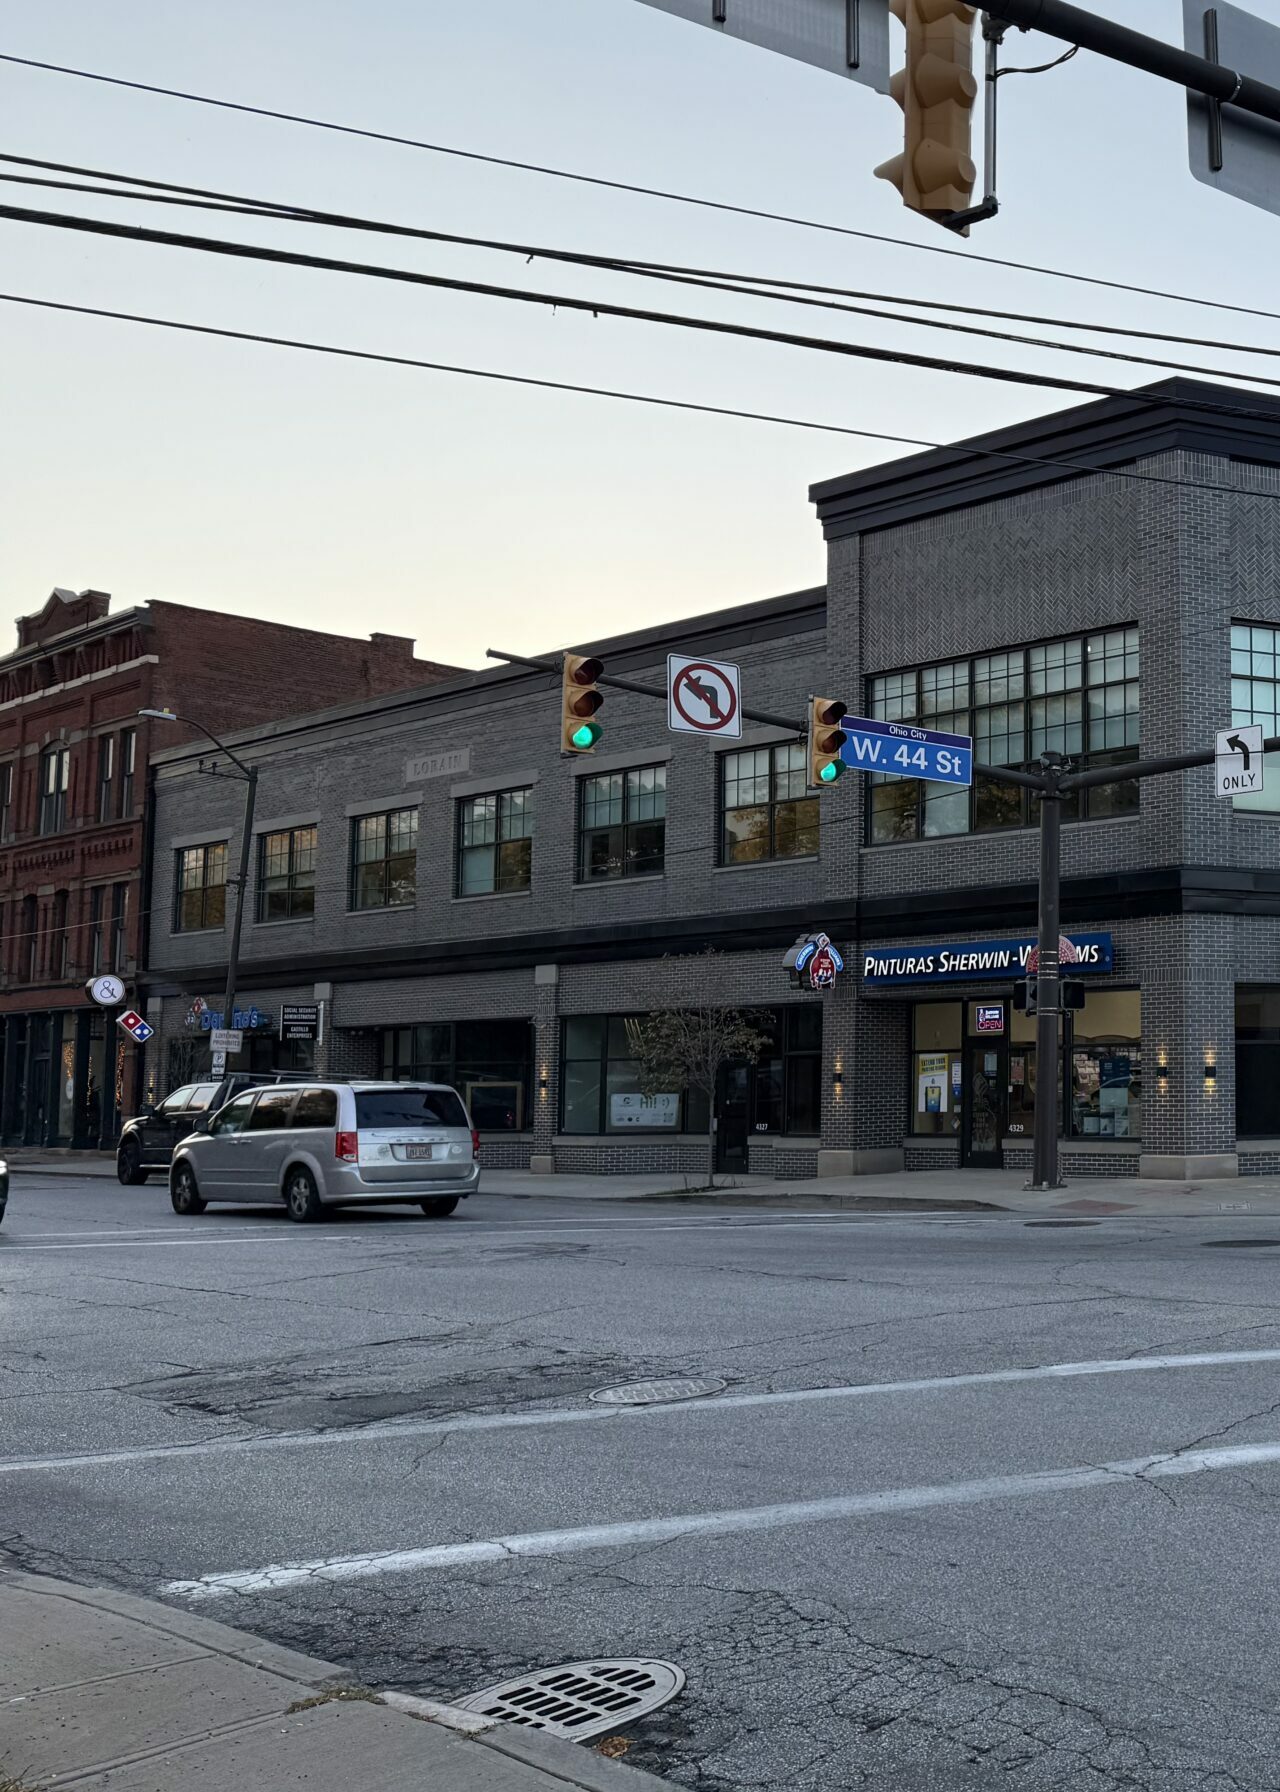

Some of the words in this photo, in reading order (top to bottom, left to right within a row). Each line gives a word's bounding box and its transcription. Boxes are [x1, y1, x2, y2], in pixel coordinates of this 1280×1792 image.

[889, 725, 908, 738] Ohio
[910, 728, 927, 741] City
[852, 736, 888, 765] W.
[893, 745, 928, 770] 44
[936, 751, 962, 776] St
[1223, 773, 1255, 790] ONLY
[864, 955, 934, 977] PINTURAS
[978, 1020, 1002, 1030] OPEN
[1008, 1124, 1025, 1133] 4329
